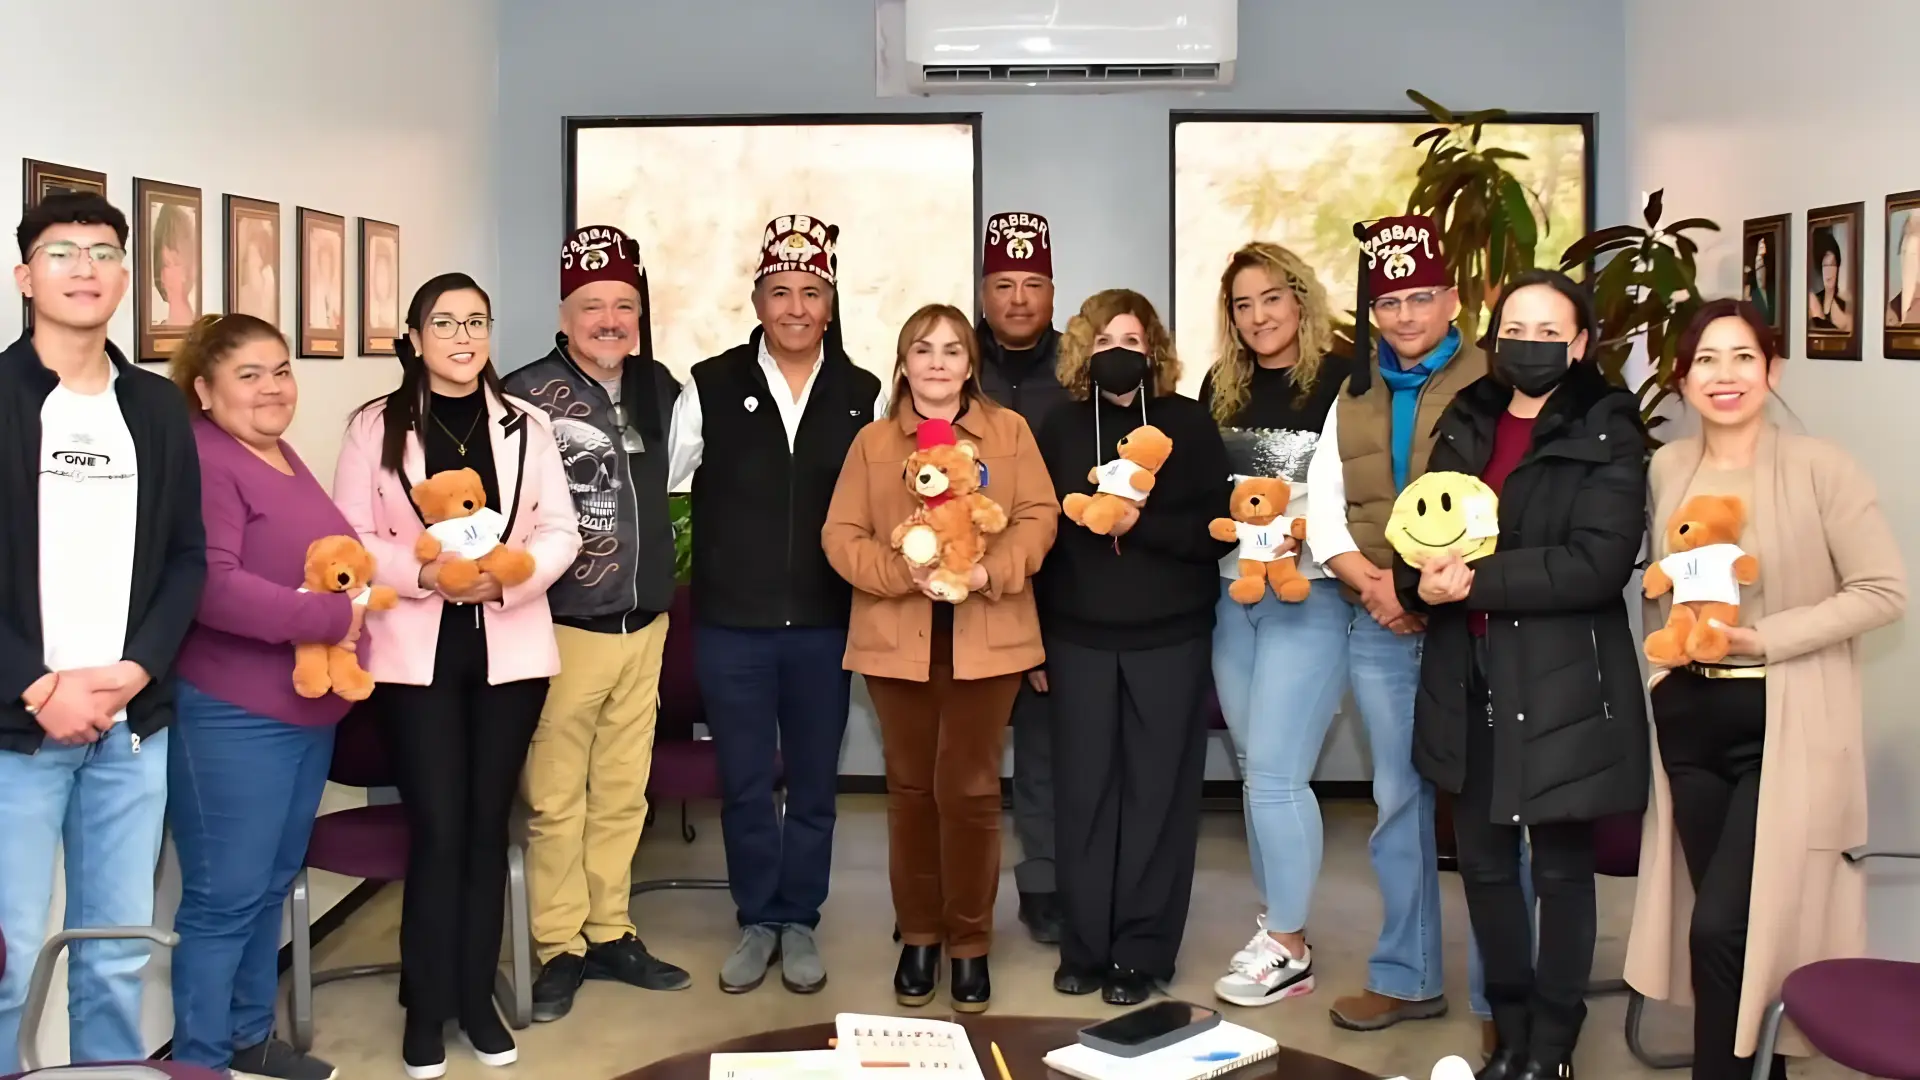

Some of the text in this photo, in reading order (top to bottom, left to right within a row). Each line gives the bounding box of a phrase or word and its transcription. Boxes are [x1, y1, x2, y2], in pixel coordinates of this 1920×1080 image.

[989, 213, 1048, 250] SABBAR
[1359, 224, 1434, 270] SABBAR
[64, 455, 97, 467] ONE
